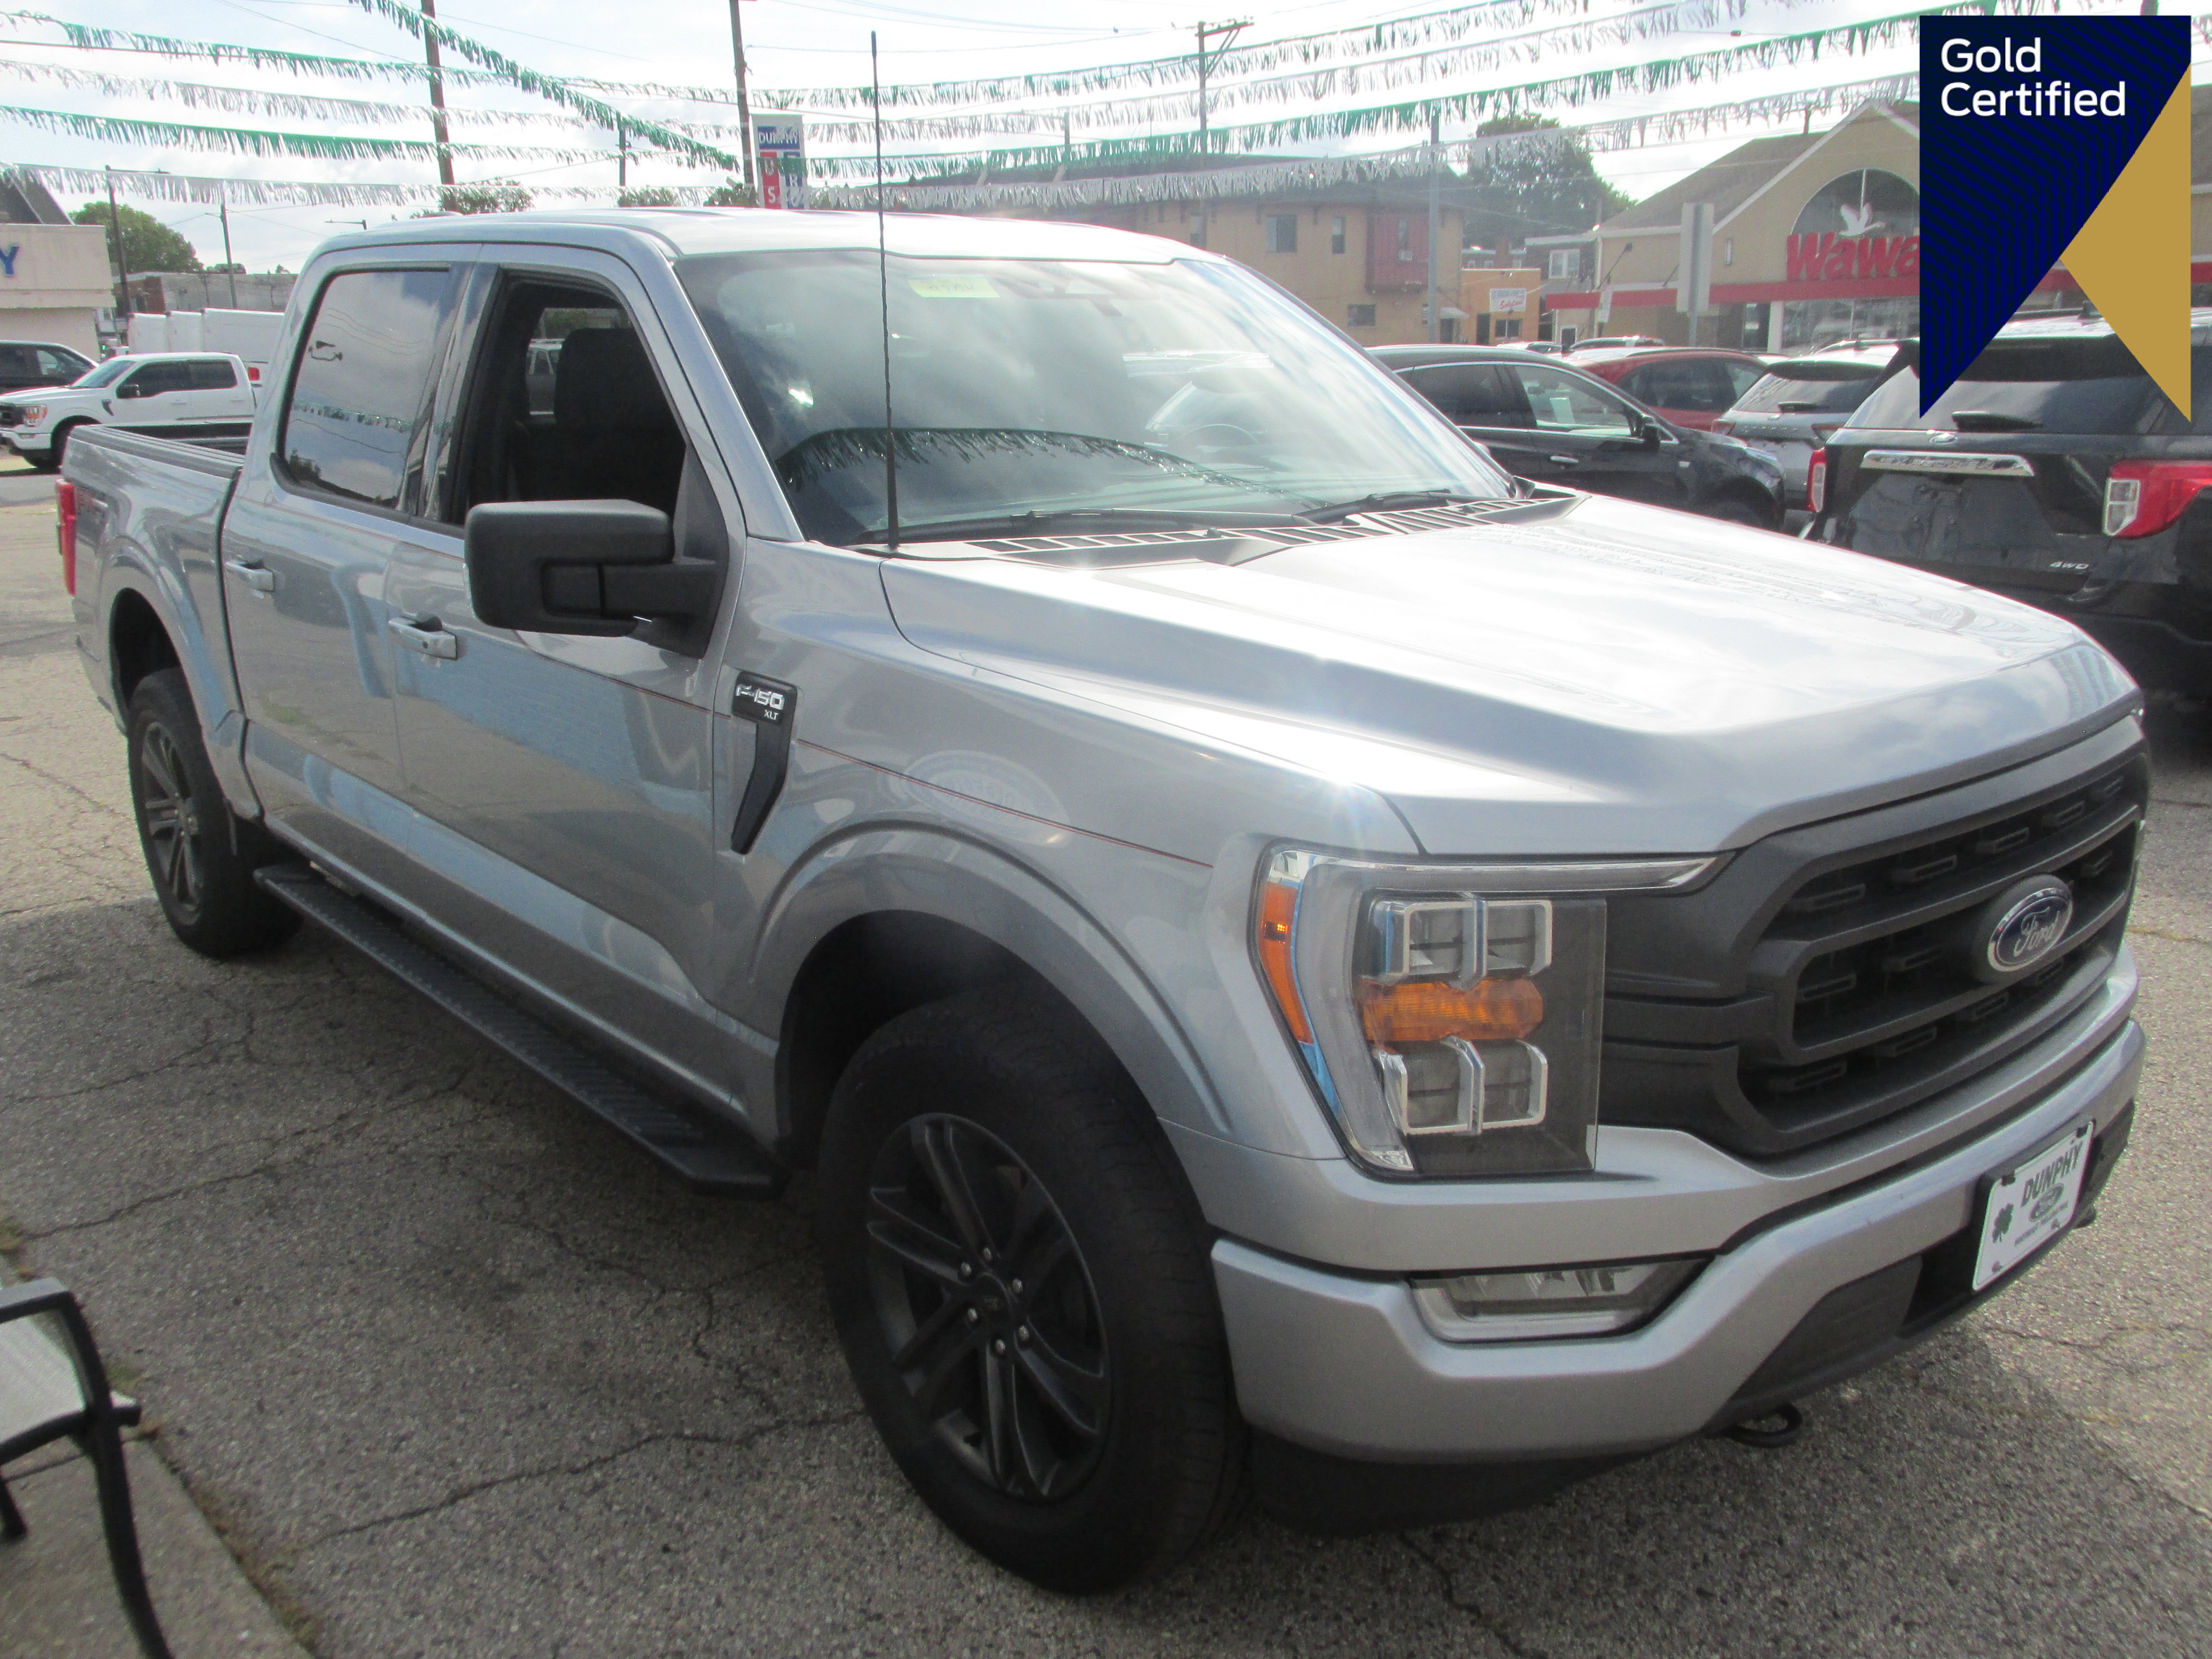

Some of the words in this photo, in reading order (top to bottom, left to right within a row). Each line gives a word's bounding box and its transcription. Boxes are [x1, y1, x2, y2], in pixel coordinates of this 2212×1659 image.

[758, 131, 799, 144] DUHY
[1787, 231, 1920, 279] Wawa
[2049, 560, 2090, 570] 4WD
[735, 684, 785, 710] F-150
[764, 709, 779, 721] XLT
[2012, 905, 2061, 957] Ford
[2020, 1139, 2084, 1207] DUNPHY
